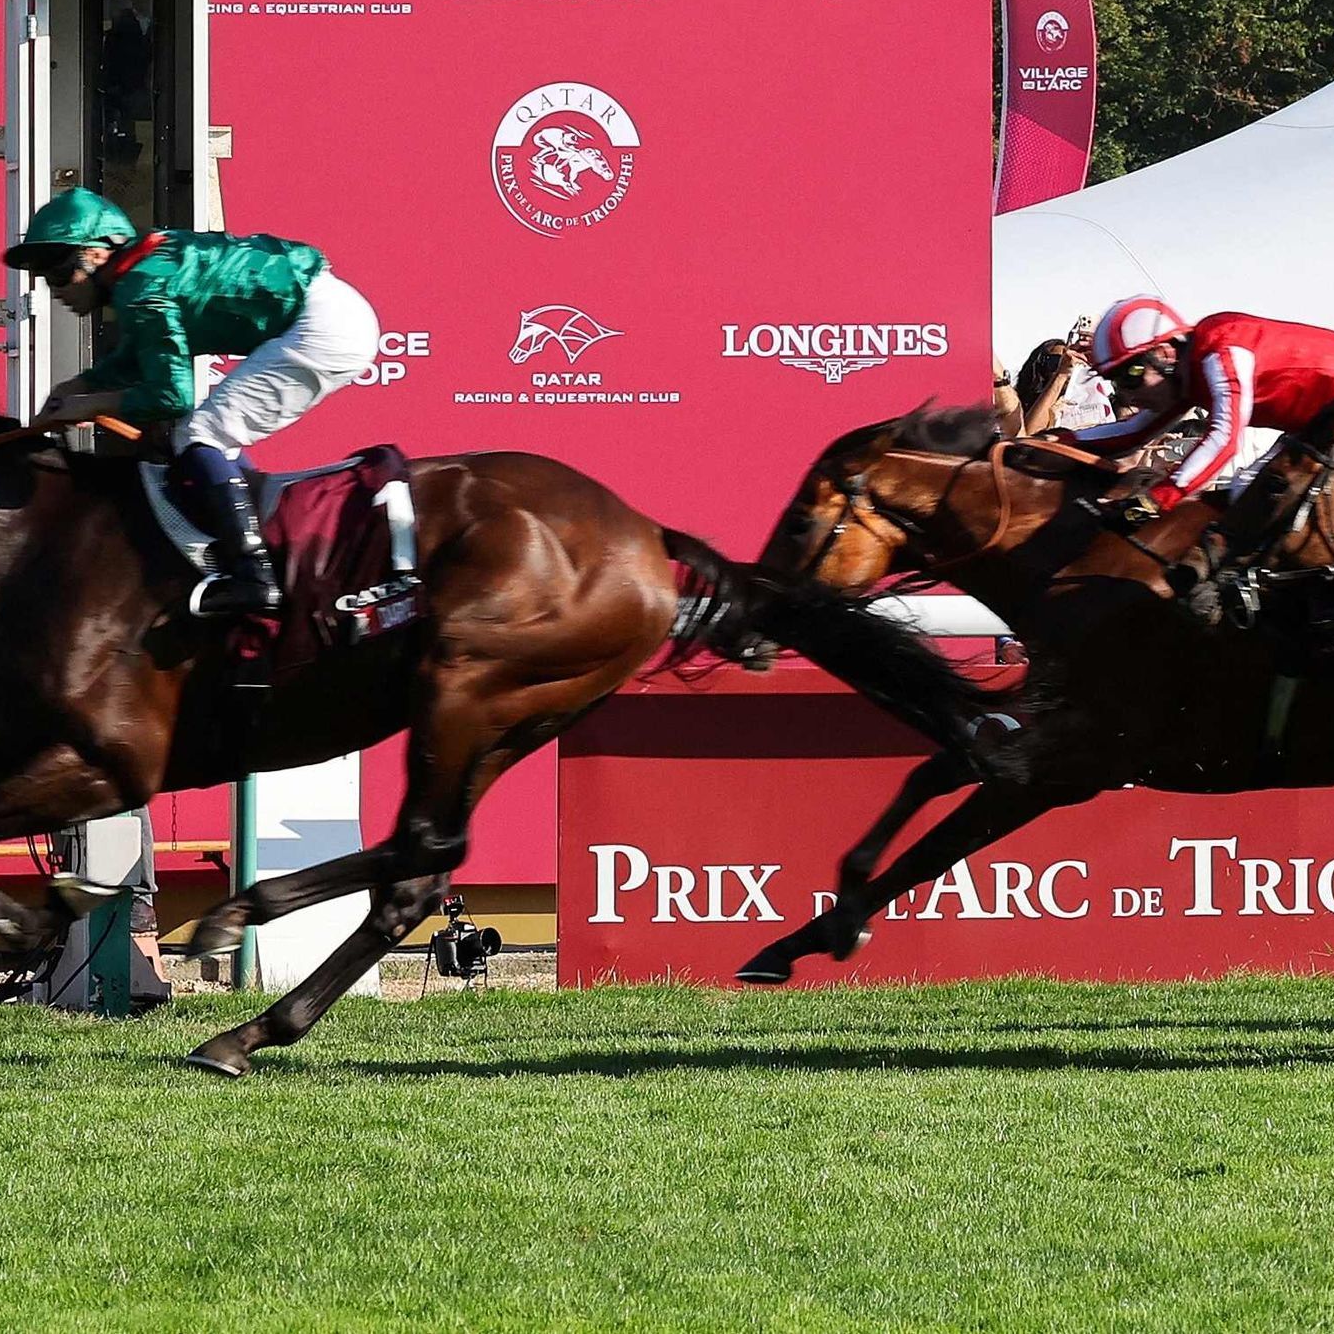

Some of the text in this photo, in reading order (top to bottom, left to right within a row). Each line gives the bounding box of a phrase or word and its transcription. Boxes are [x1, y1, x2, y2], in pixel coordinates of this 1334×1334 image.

[208, 3, 412, 15] CING & EQUESTRIAN CLUB
[1019, 67, 1088, 79] VILLAGE
[1037, 79, 1082, 91] L'ARC
[516, 88, 617, 125] QATAR
[500, 153, 519, 194] PRIX
[515, 192, 528, 207] DE
[565, 217, 579, 226] DE
[581, 153, 633, 227] TRIOMPHE
[722, 323, 948, 358] LONGINES
[533, 373, 602, 388] QATAR
[454, 392, 680, 405] RACING & EQUESTRIAN CLUB
[372, 481, 415, 570] 1
[588, 844, 785, 923] PRIX
[1112, 887, 1165, 917] DE
